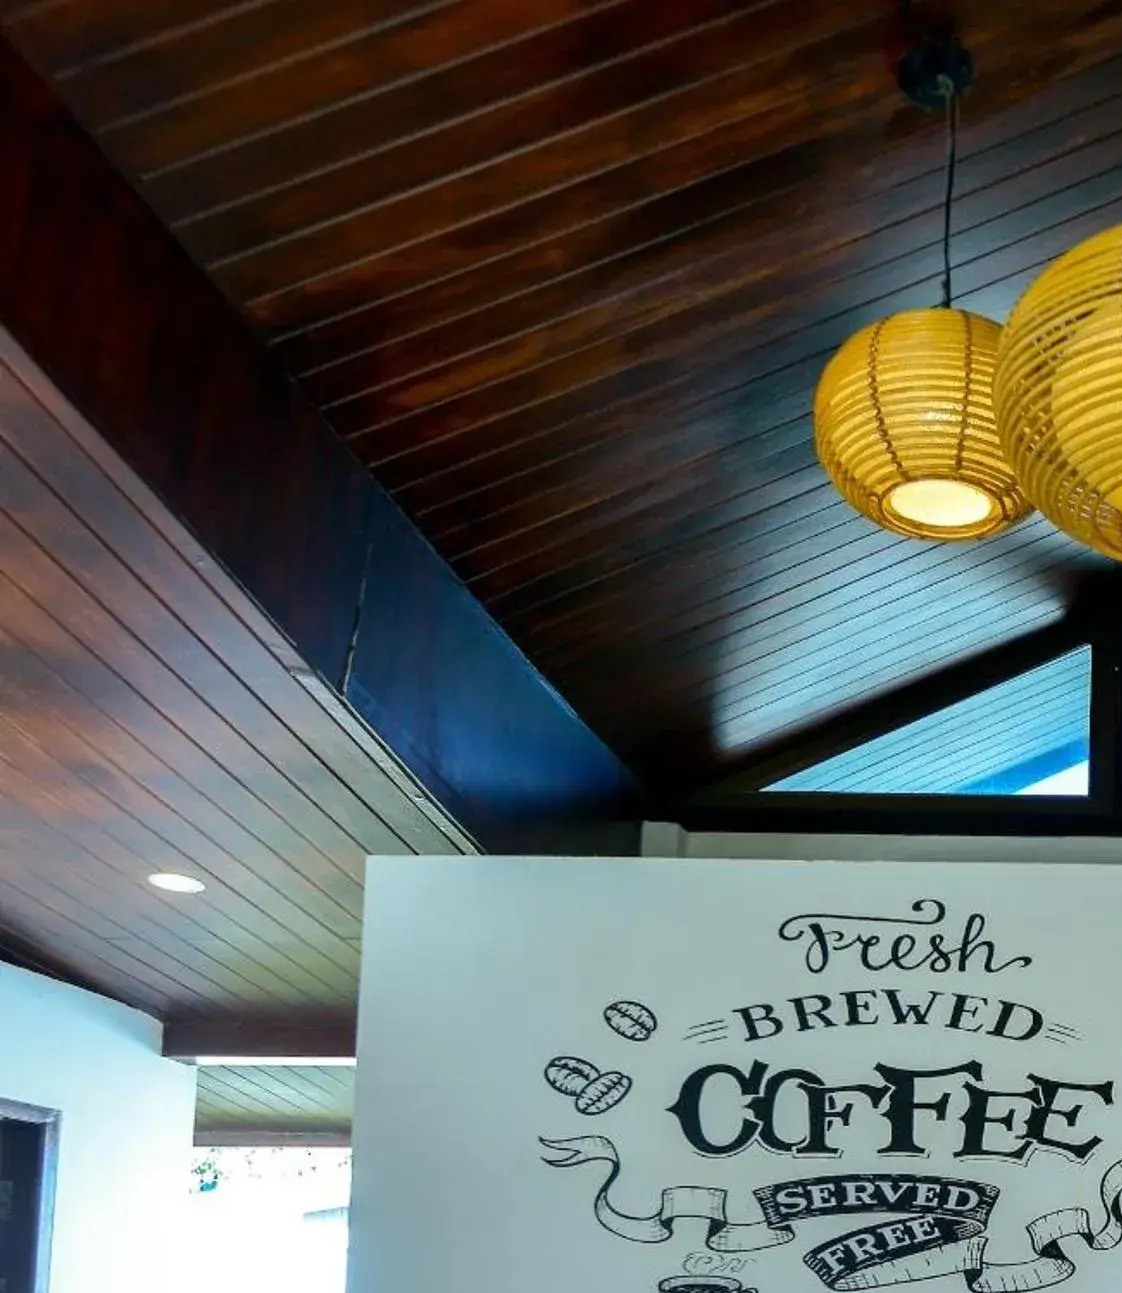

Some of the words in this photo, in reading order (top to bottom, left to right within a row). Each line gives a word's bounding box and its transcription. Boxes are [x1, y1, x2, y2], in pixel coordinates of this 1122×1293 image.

[778, 899, 1033, 974] Fresh
[732, 989, 1045, 1042] BREWED
[666, 1059, 1114, 1165] COFFEE
[776, 1179, 981, 1214] SERVED
[821, 1217, 943, 1275] FREE
